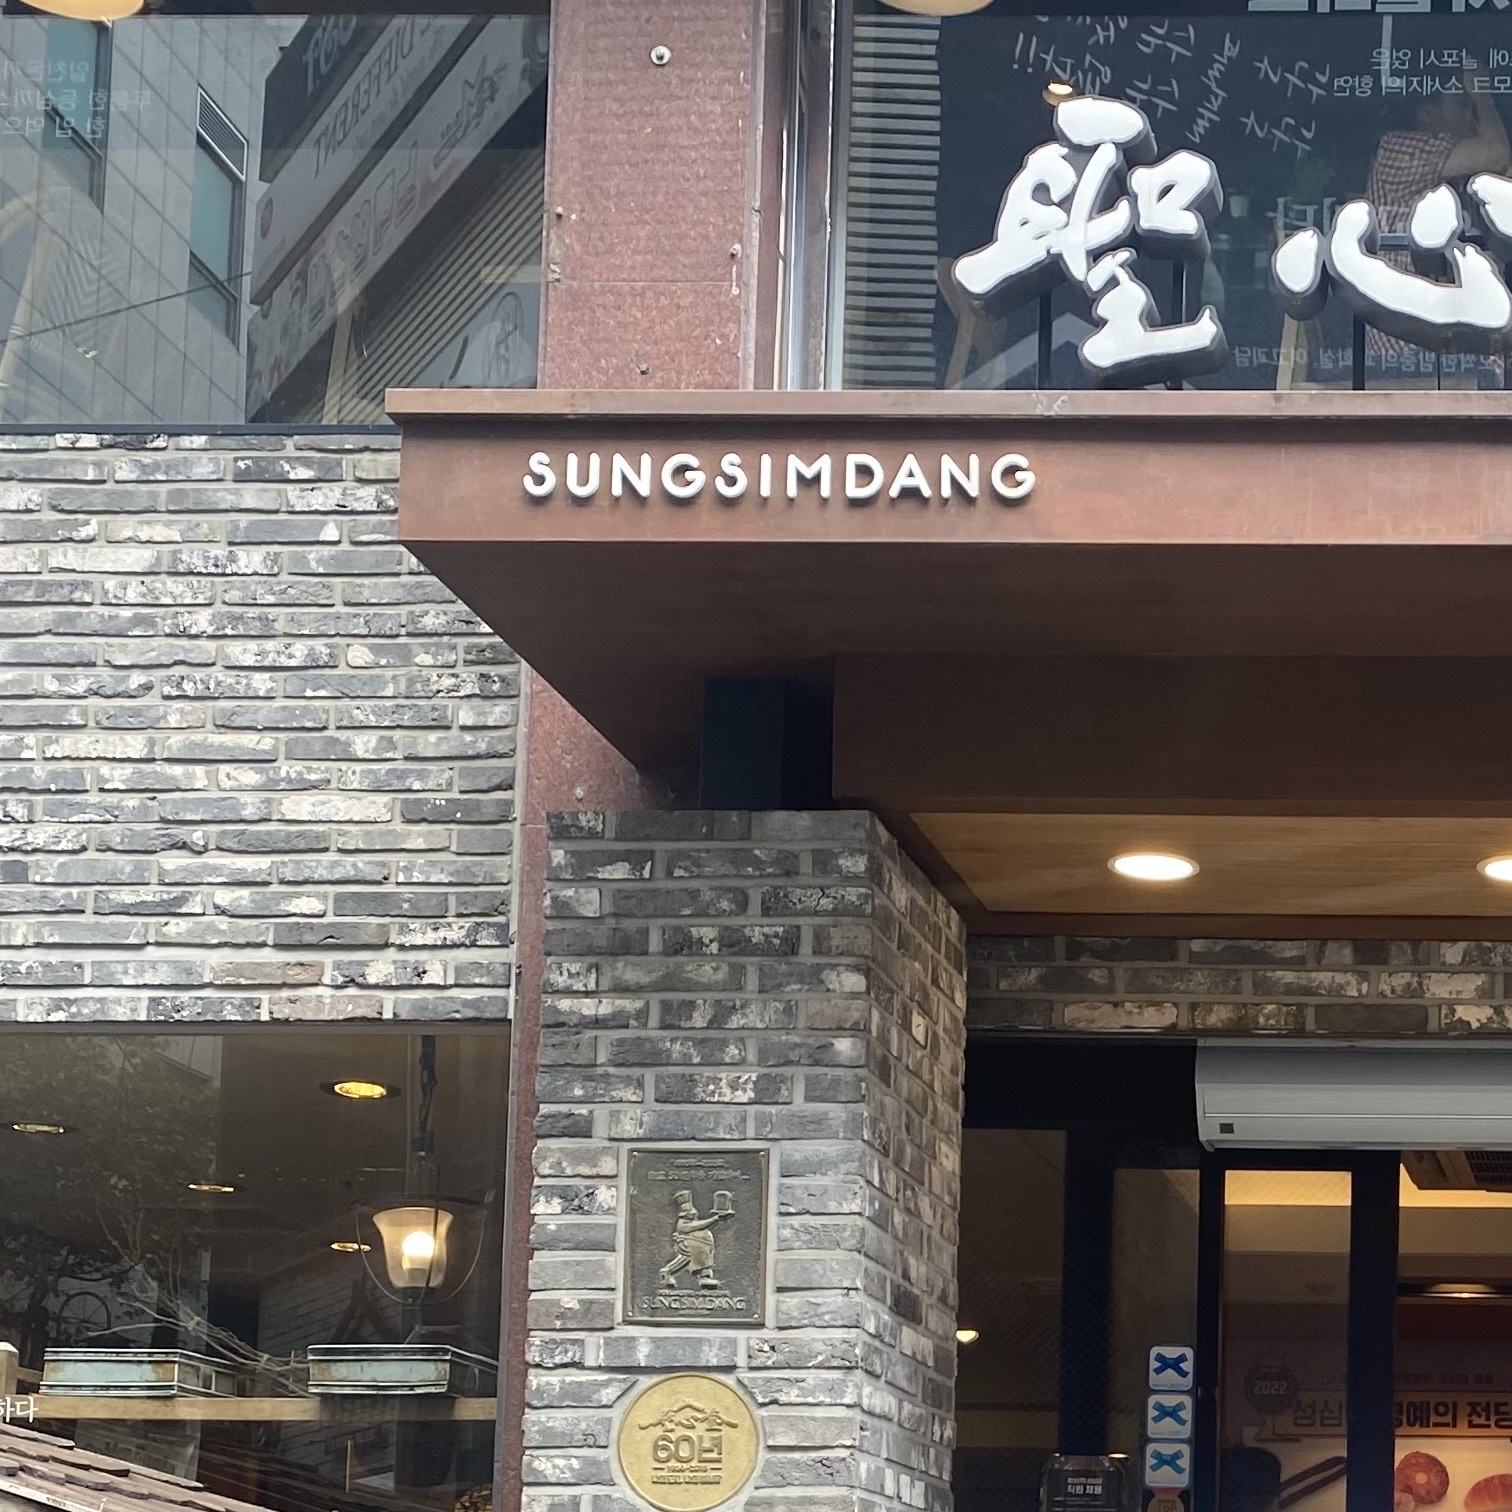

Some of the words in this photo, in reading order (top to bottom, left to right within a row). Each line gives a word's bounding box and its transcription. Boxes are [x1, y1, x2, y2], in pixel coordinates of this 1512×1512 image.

[523, 450, 1037, 499] SUNGSIMDANG
[1253, 1381, 1288, 1395] 2022
[652, 1433, 723, 1463] 60년
